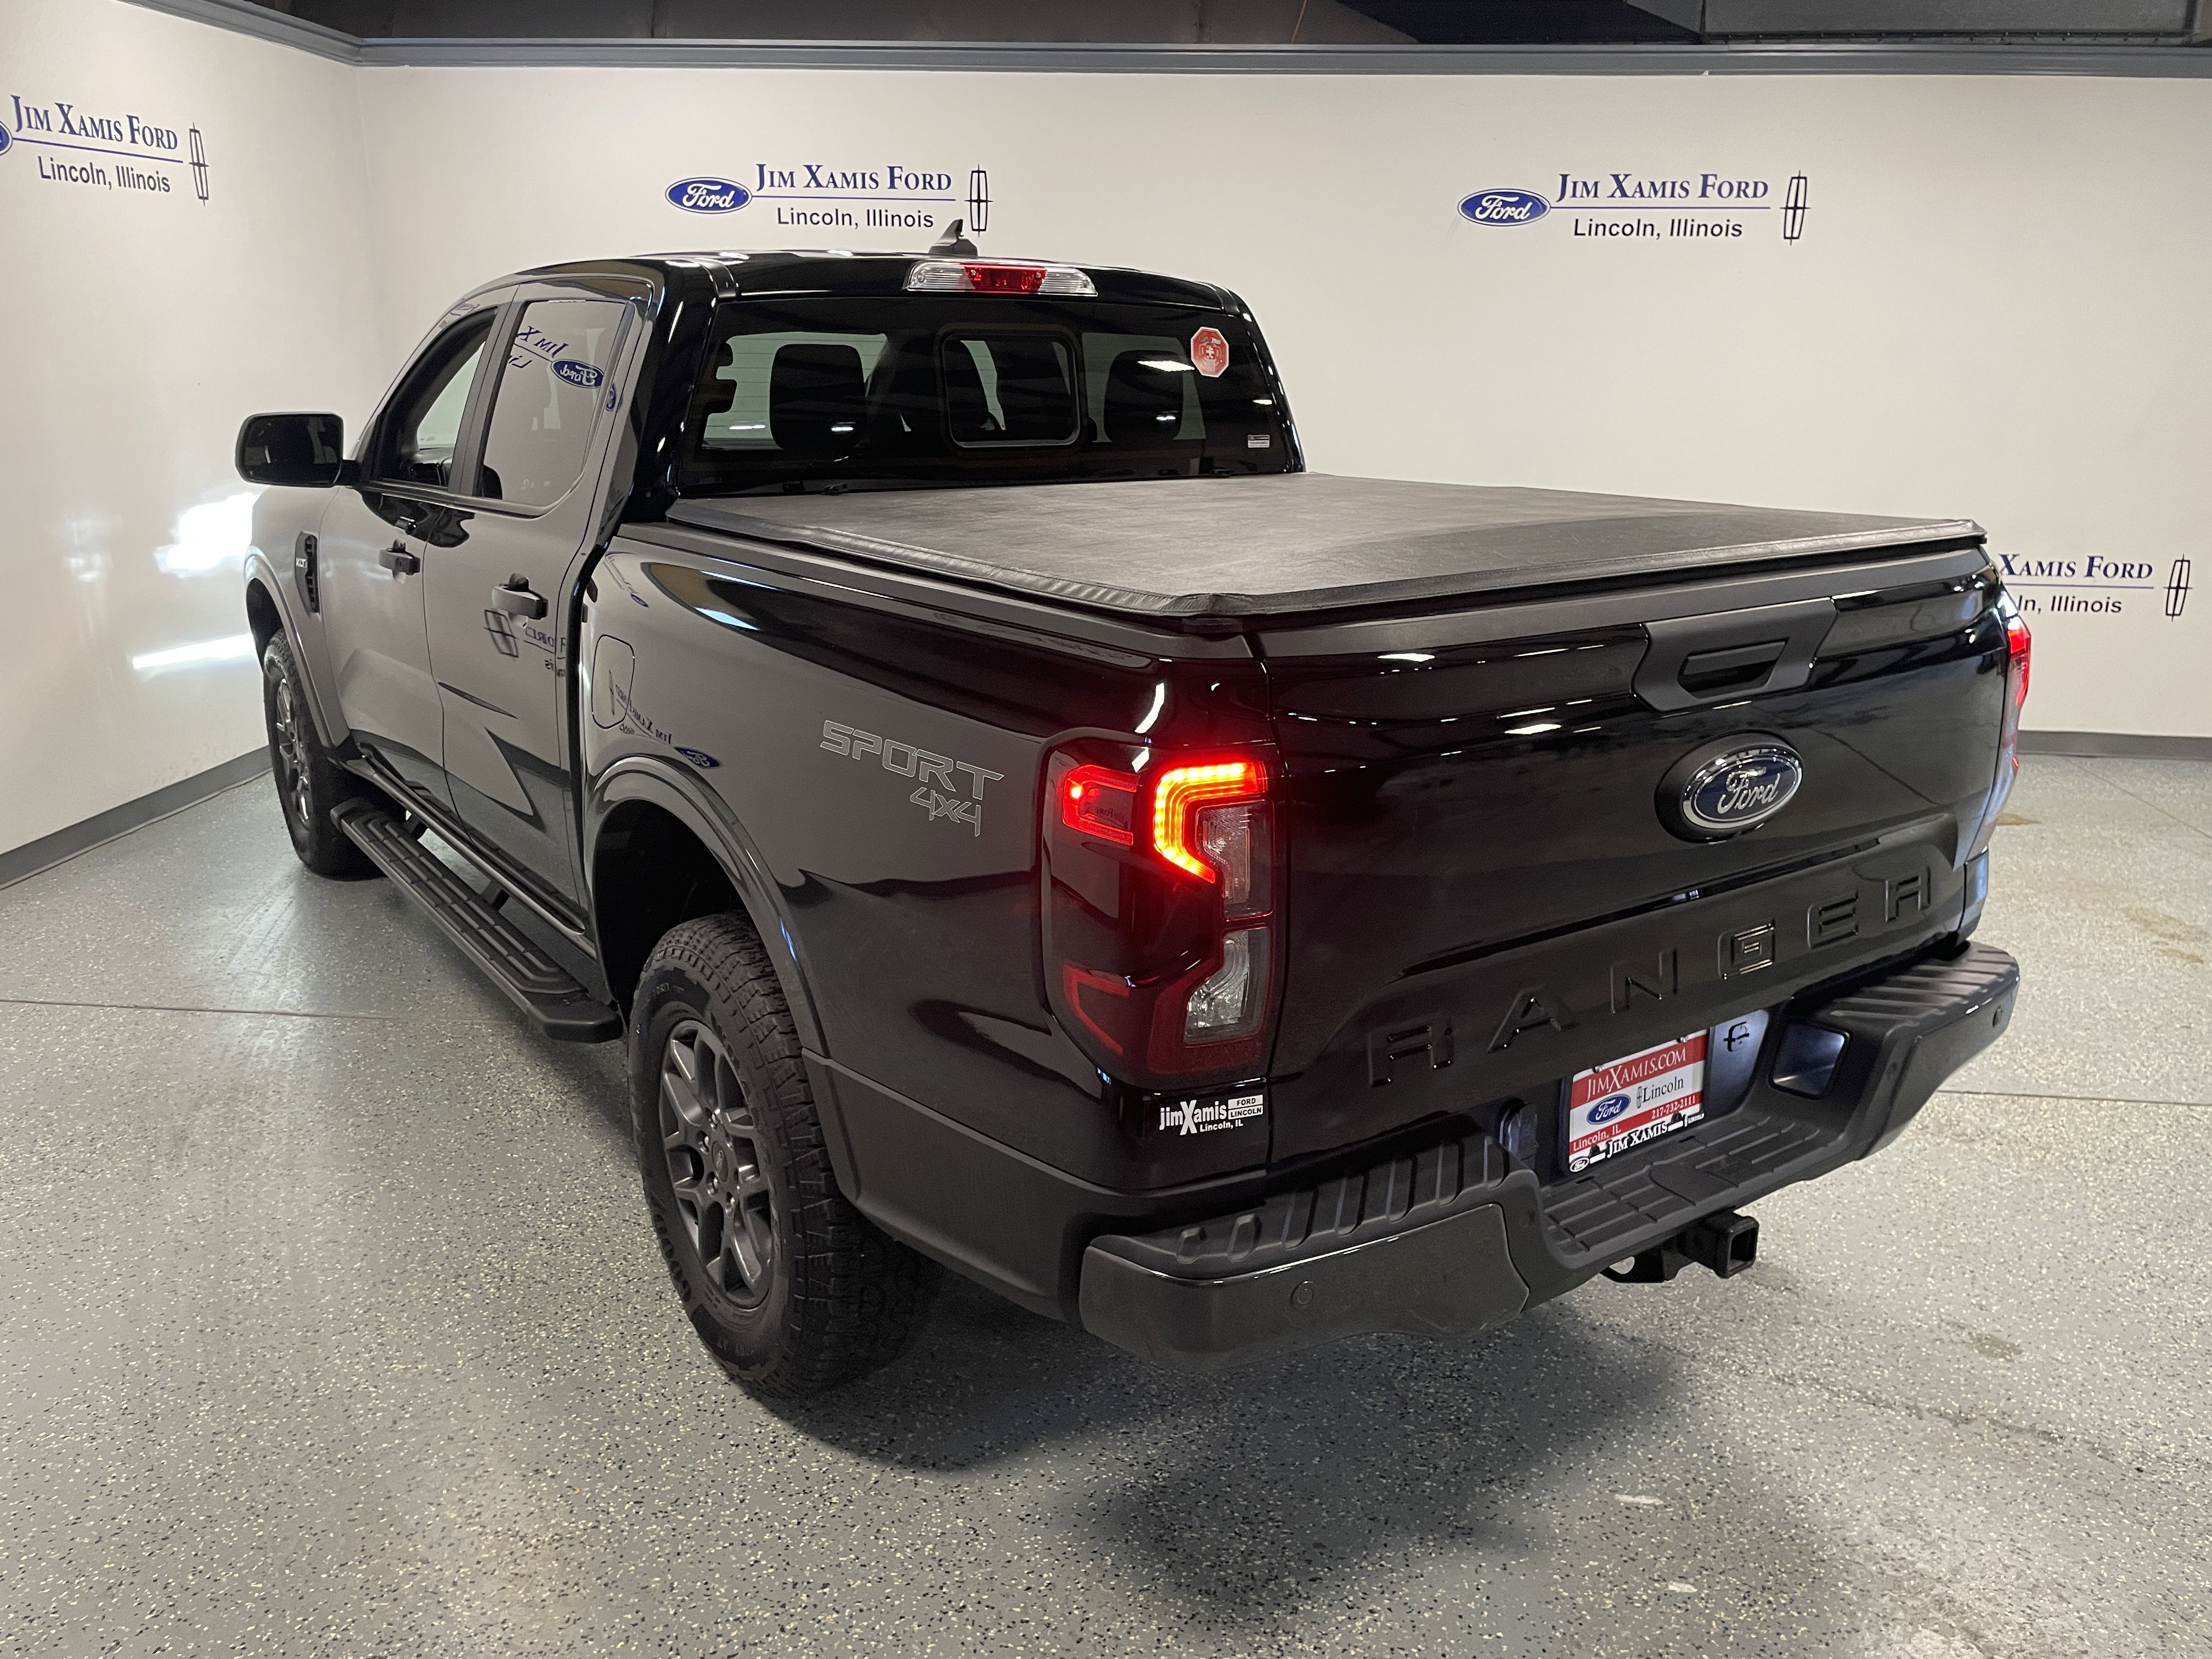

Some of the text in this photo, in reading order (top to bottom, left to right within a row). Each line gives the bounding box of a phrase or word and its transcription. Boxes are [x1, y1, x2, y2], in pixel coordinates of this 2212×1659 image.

[10, 94, 178, 150] JIM XAMIS FORD
[37, 156, 171, 193] Lincoln, Illinois
[755, 163, 952, 191] JIM XAMIS FORD
[1556, 173, 1768, 202] JIM XAMIS FORD
[682, 183, 735, 208] Ford
[1475, 195, 1530, 221] Ford
[777, 207, 934, 229] Lincoln, Illinois
[1573, 218, 1743, 240] Lincoln, Illinois
[1999, 553, 2153, 579] XAMIS FORD
[2051, 596, 2121, 613] Illinois
[820, 720, 1005, 800] SPORT
[1717, 766, 1781, 815] Ford
[1368, 867, 1931, 1087] RANGER
[1587, 1047, 1686, 1101] JIMXAMIS.COM
[1237, 1098, 1256, 1106] FORD
[1595, 1076, 1684, 1120] Ford Lincoln
[1159, 1099, 1227, 1136] jimXamis
[1200, 1121, 1233, 1132] Lincoln,
[1231, 1107, 1261, 1118] LINCOLN
[1607, 1122, 1667, 1158] JIM XAMIS
[1612, 1125, 1621, 1139] IL
